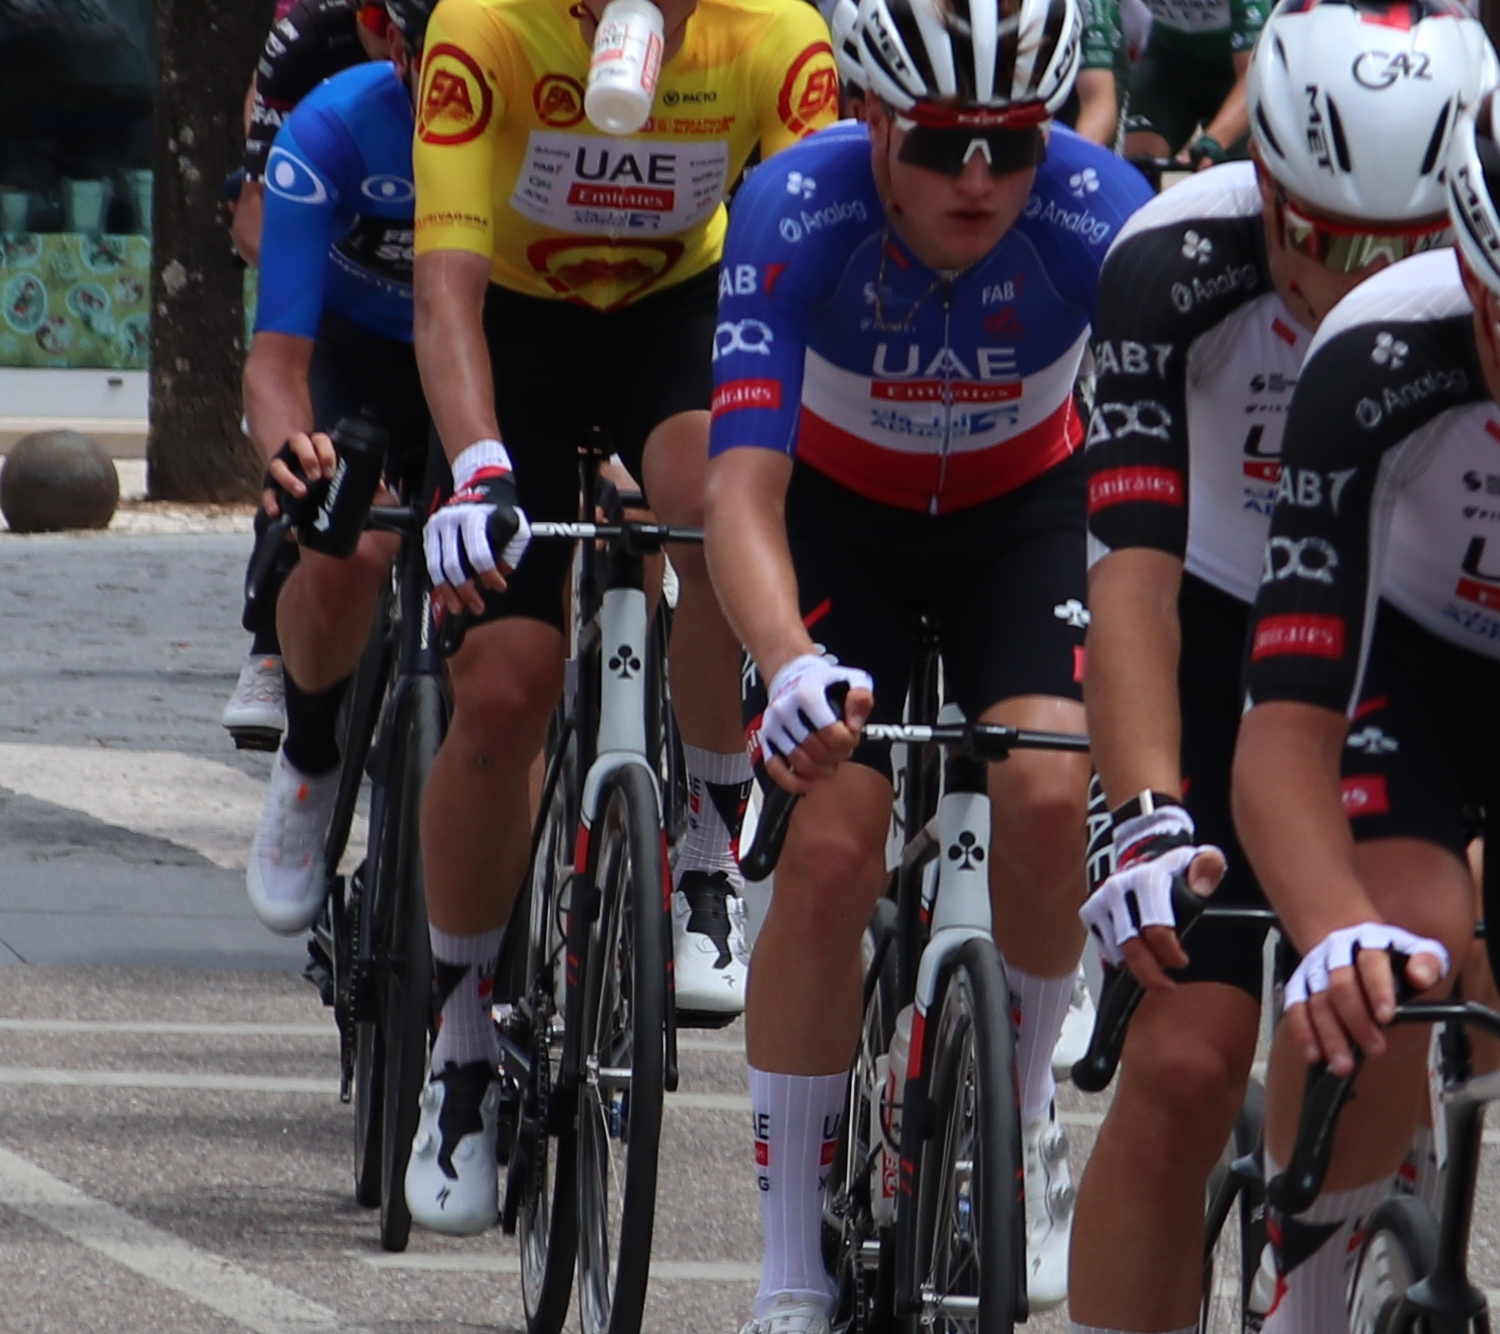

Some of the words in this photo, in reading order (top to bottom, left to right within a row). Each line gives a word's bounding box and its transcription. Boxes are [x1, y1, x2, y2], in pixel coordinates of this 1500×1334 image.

[870, 9, 912, 78] MET
[1352, 50, 1434, 90] G42
[1305, 84, 1335, 176] MET
[575, 146, 676, 185] UAE
[579, 188, 664, 207] Emirates
[801, 198, 867, 234] Analog
[1039, 200, 1112, 245] Analog
[719, 264, 757, 299] AB
[982, 281, 1015, 305] FAB
[1193, 263, 1257, 303] Analog
[871, 343, 1017, 380] UAE
[886, 385, 1009, 401] Emirates
[1382, 368, 1469, 415] Analog
[1275, 468, 1321, 506] AB
